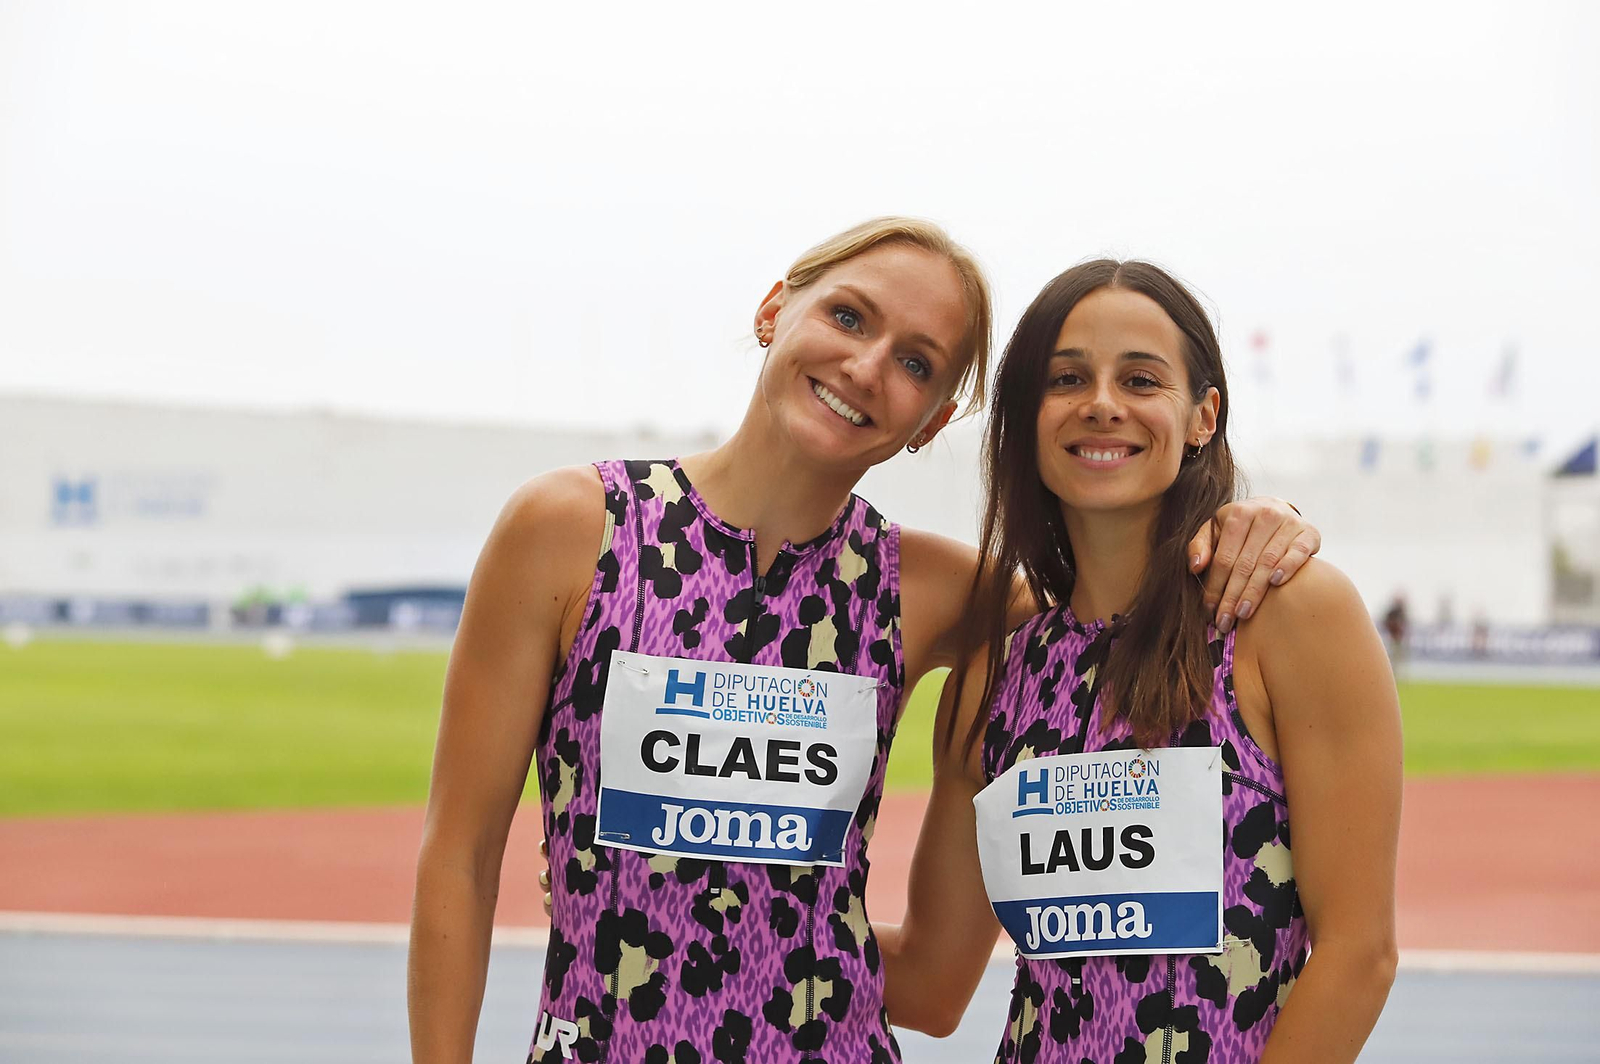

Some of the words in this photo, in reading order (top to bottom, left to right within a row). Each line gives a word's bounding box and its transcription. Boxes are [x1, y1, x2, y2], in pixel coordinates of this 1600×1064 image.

[714, 672, 828, 698] DIPUTACIÓN
[712, 691, 735, 709] DE
[747, 695, 827, 716] HUELVA
[712, 710, 785, 725] OBJETIVOS
[785, 718, 827, 729] SOSTENIBLE
[793, 713, 827, 722] DESARROLLO
[640, 730, 838, 786] CLAES
[1055, 753, 1160, 783] DIPUTACIÓN
[1055, 784, 1074, 801] DE
[1083, 779, 1159, 799] HUELVA
[1055, 798, 1117, 815] OBJETIVOS
[1117, 801, 1160, 811] SOSTENIBLE
[1020, 824, 1155, 876] LAUS
